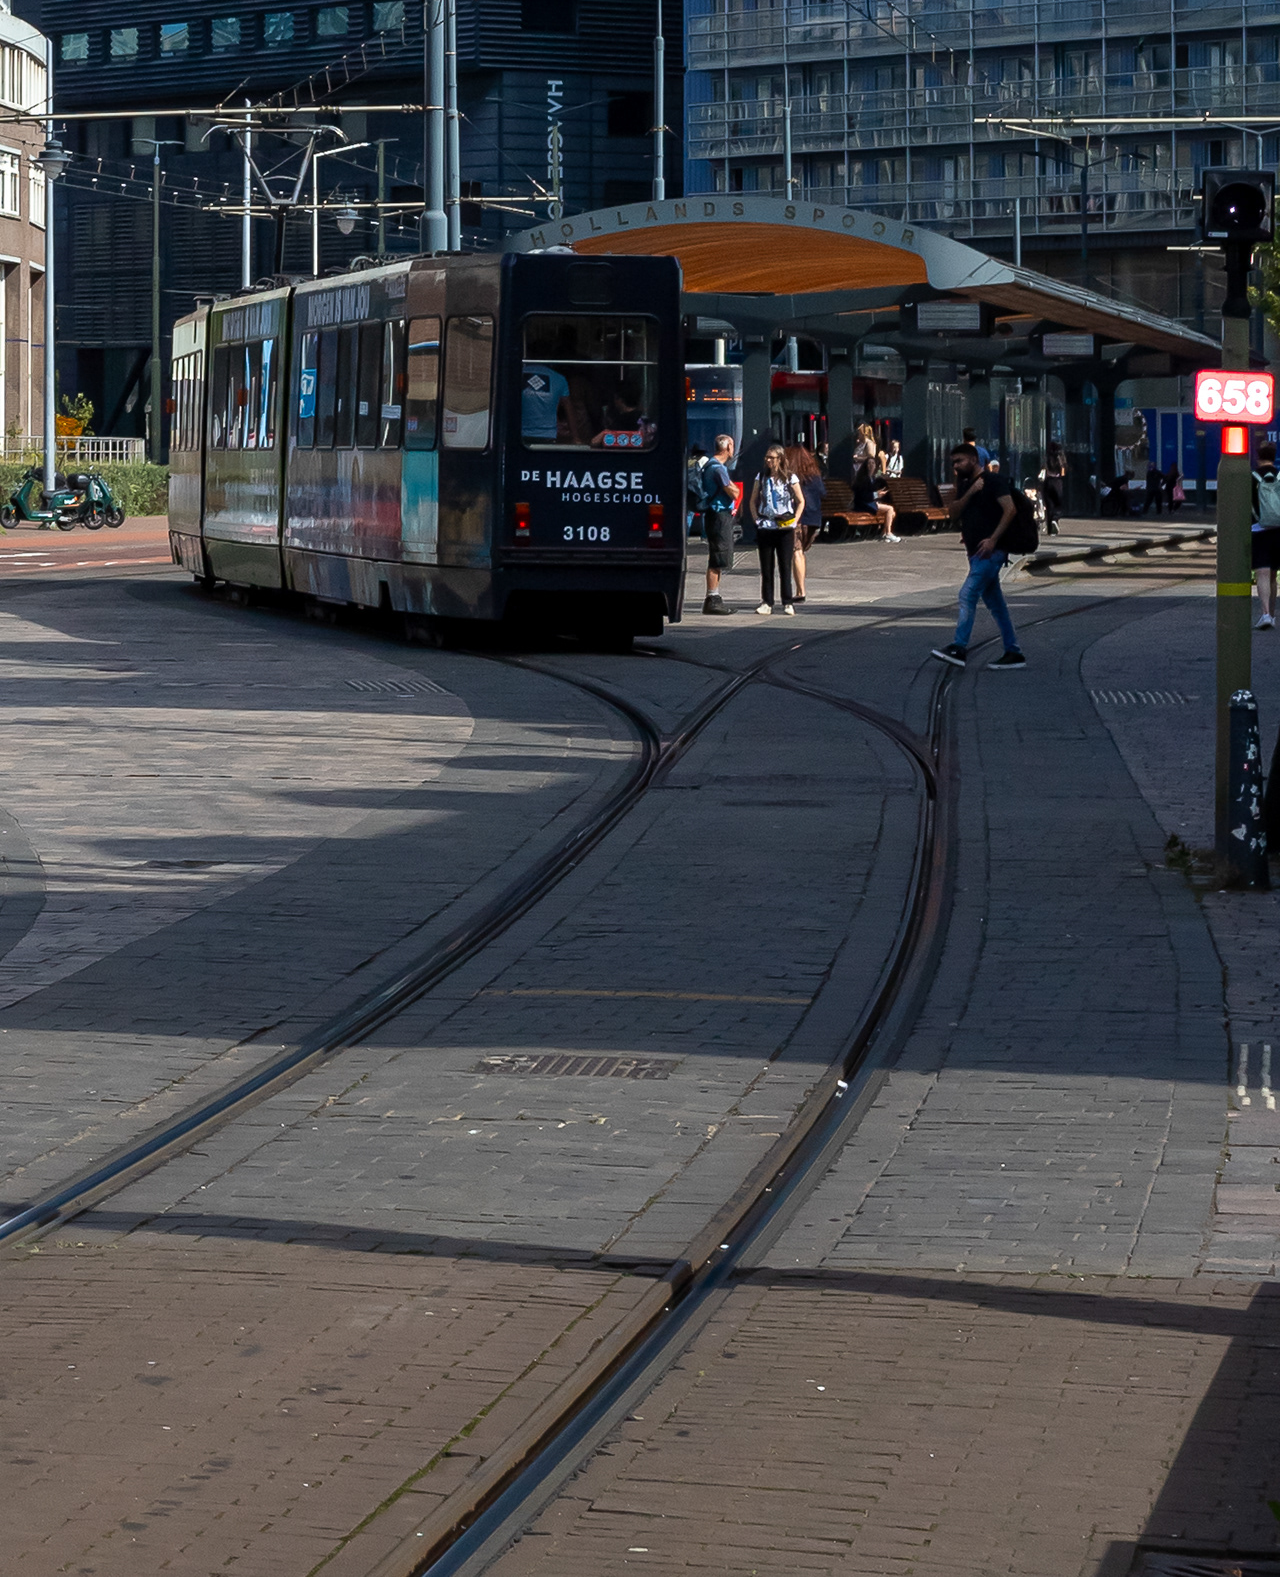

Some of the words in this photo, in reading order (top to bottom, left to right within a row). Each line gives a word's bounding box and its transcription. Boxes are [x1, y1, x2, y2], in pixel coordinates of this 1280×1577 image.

[529, 201, 744, 247] HOLLANDS
[784, 204, 915, 246] SPOOR
[1196, 377, 1270, 416] 658
[521, 470, 540, 482] DE
[546, 470, 643, 490] HAAGSE
[561, 492, 662, 504] HOGESCHOOL
[563, 525, 610, 542] 3108
